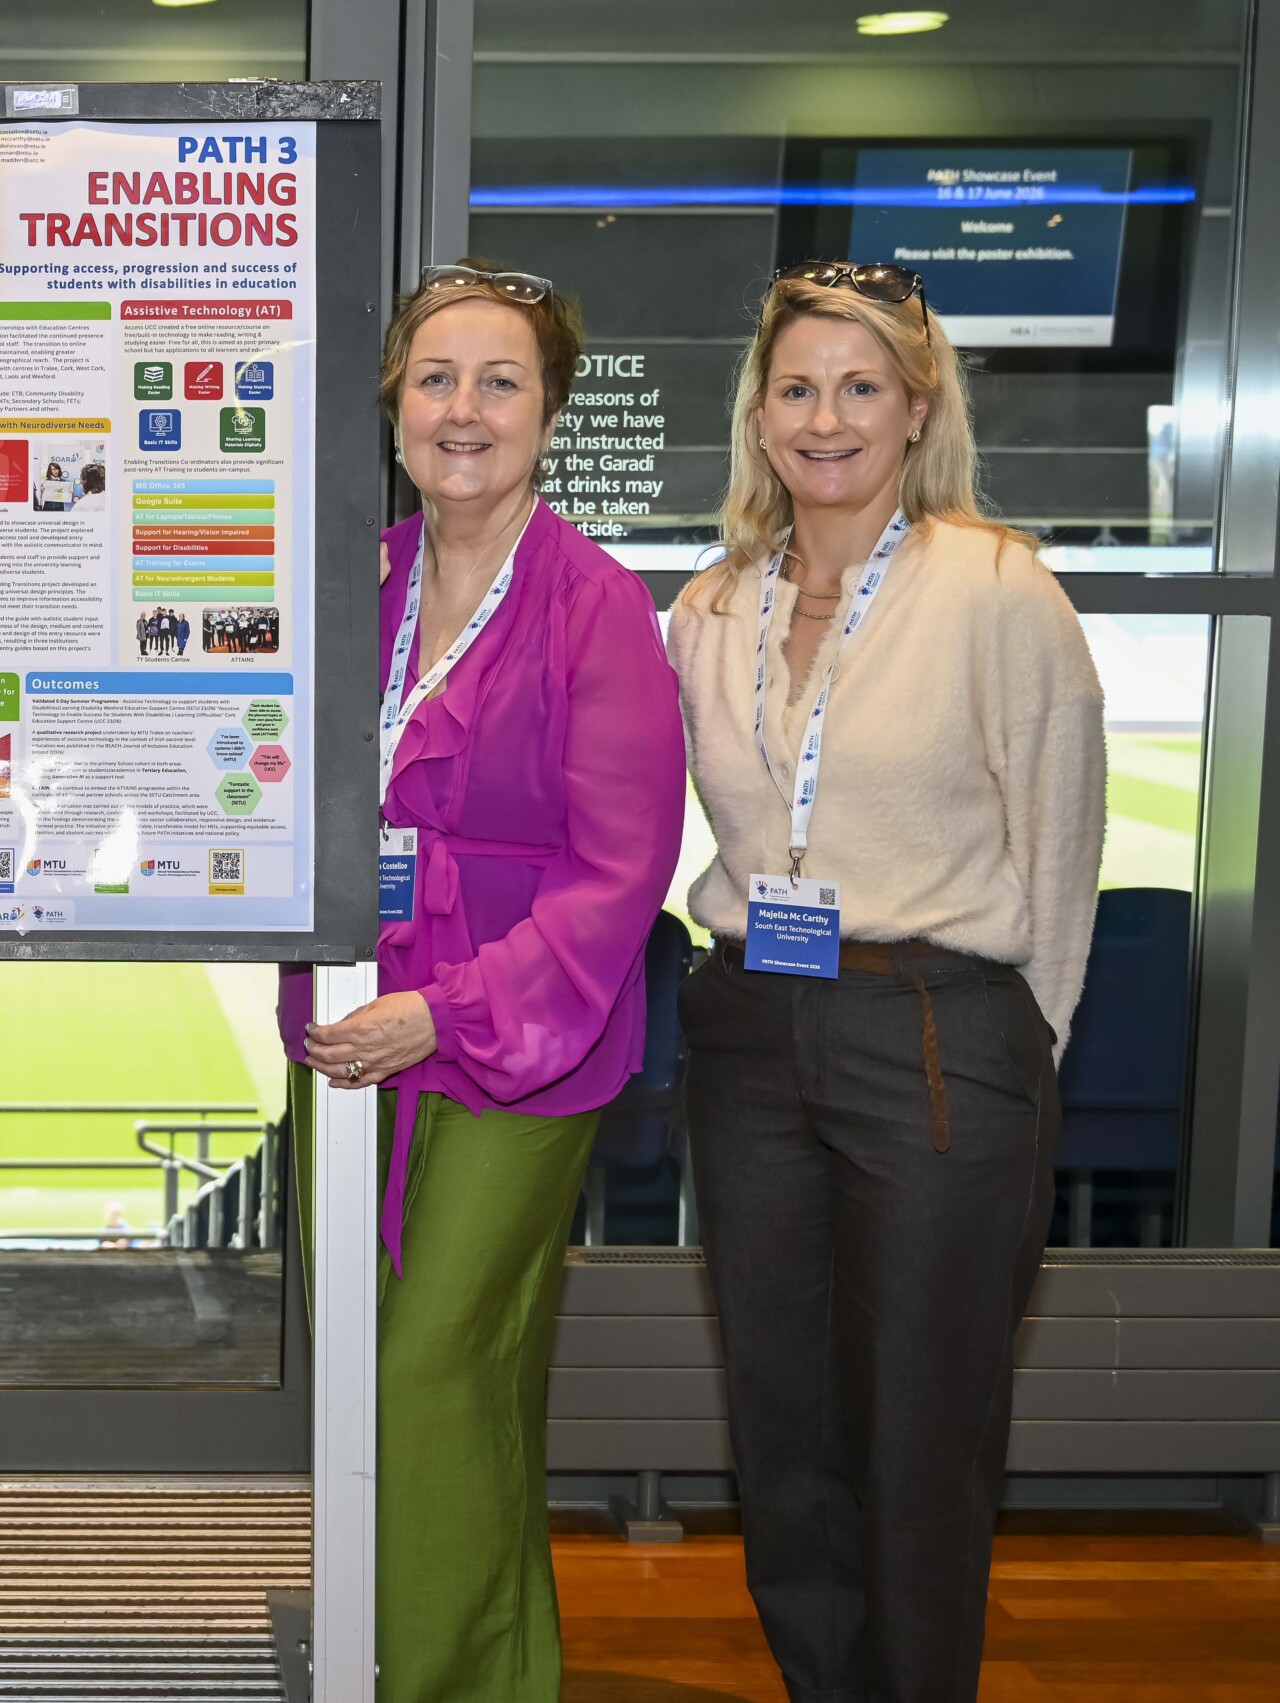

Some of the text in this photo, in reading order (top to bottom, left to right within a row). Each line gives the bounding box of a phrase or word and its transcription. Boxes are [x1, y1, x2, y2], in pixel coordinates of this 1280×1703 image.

[178, 136, 297, 164] PATH 3
[962, 170, 1020, 183] Showcase
[1023, 169, 1057, 183] Event
[88, 172, 296, 206] ENABLING
[968, 188, 983, 199] 17
[985, 188, 1012, 200] June
[19, 213, 298, 247] TRANSITIONS
[961, 220, 1014, 234] Welcome
[894, 248, 1074, 263] Please visit the poster exhibition.
[73, 265, 118, 274] access,
[123, 265, 198, 275] progression
[203, 262, 226, 273] and
[284, 262, 297, 273] of
[47, 278, 296, 289] students with disabilities in education
[124, 305, 280, 317] Assistive Technology (AT)
[576, 355, 644, 377] OTICE
[569, 389, 659, 406] reasons of
[591, 412, 664, 427] we have
[577, 433, 664, 449] instructed
[566, 456, 593, 471] the
[568, 476, 663, 497] drinks may
[550, 498, 649, 514] ot be taken
[573, 520, 627, 536] tside.
[499, 573, 510, 587] PATH
[865, 572, 876, 589] PATH
[32, 679, 99, 689] Outcomes
[44, 860, 66, 869] MTU
[158, 861, 180, 869] MTU
[759, 909, 829, 925] Majella Mc Carthy
[776, 933, 808, 943] University
[789, 926, 832, 936] Technological
